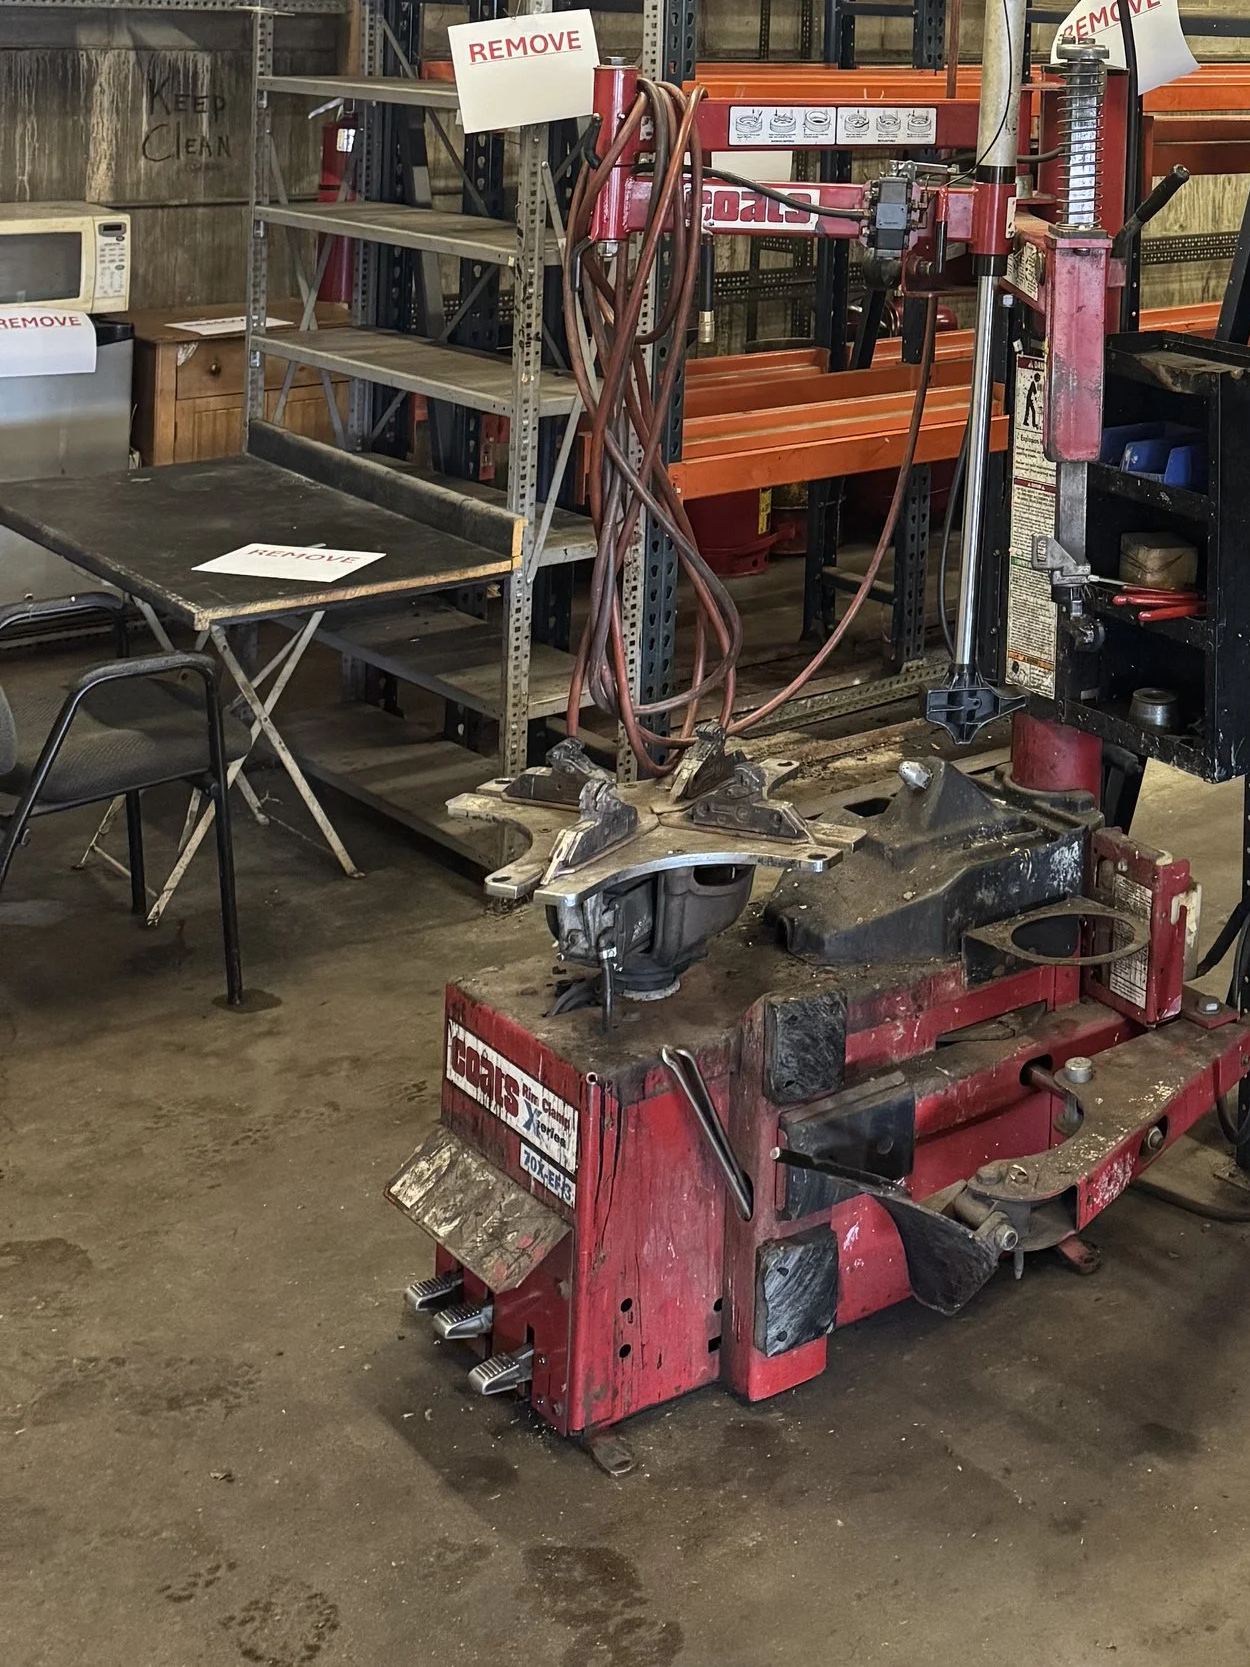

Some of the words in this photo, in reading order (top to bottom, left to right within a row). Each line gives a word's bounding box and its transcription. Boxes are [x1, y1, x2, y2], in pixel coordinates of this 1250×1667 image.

[469, 30, 582, 64] REMOVE
[0, 316, 82, 330] REMOVE
[248, 549, 360, 564] REMOVE
[522, 1082, 540, 1109] Rim
[541, 1098, 570, 1131] Clamp
